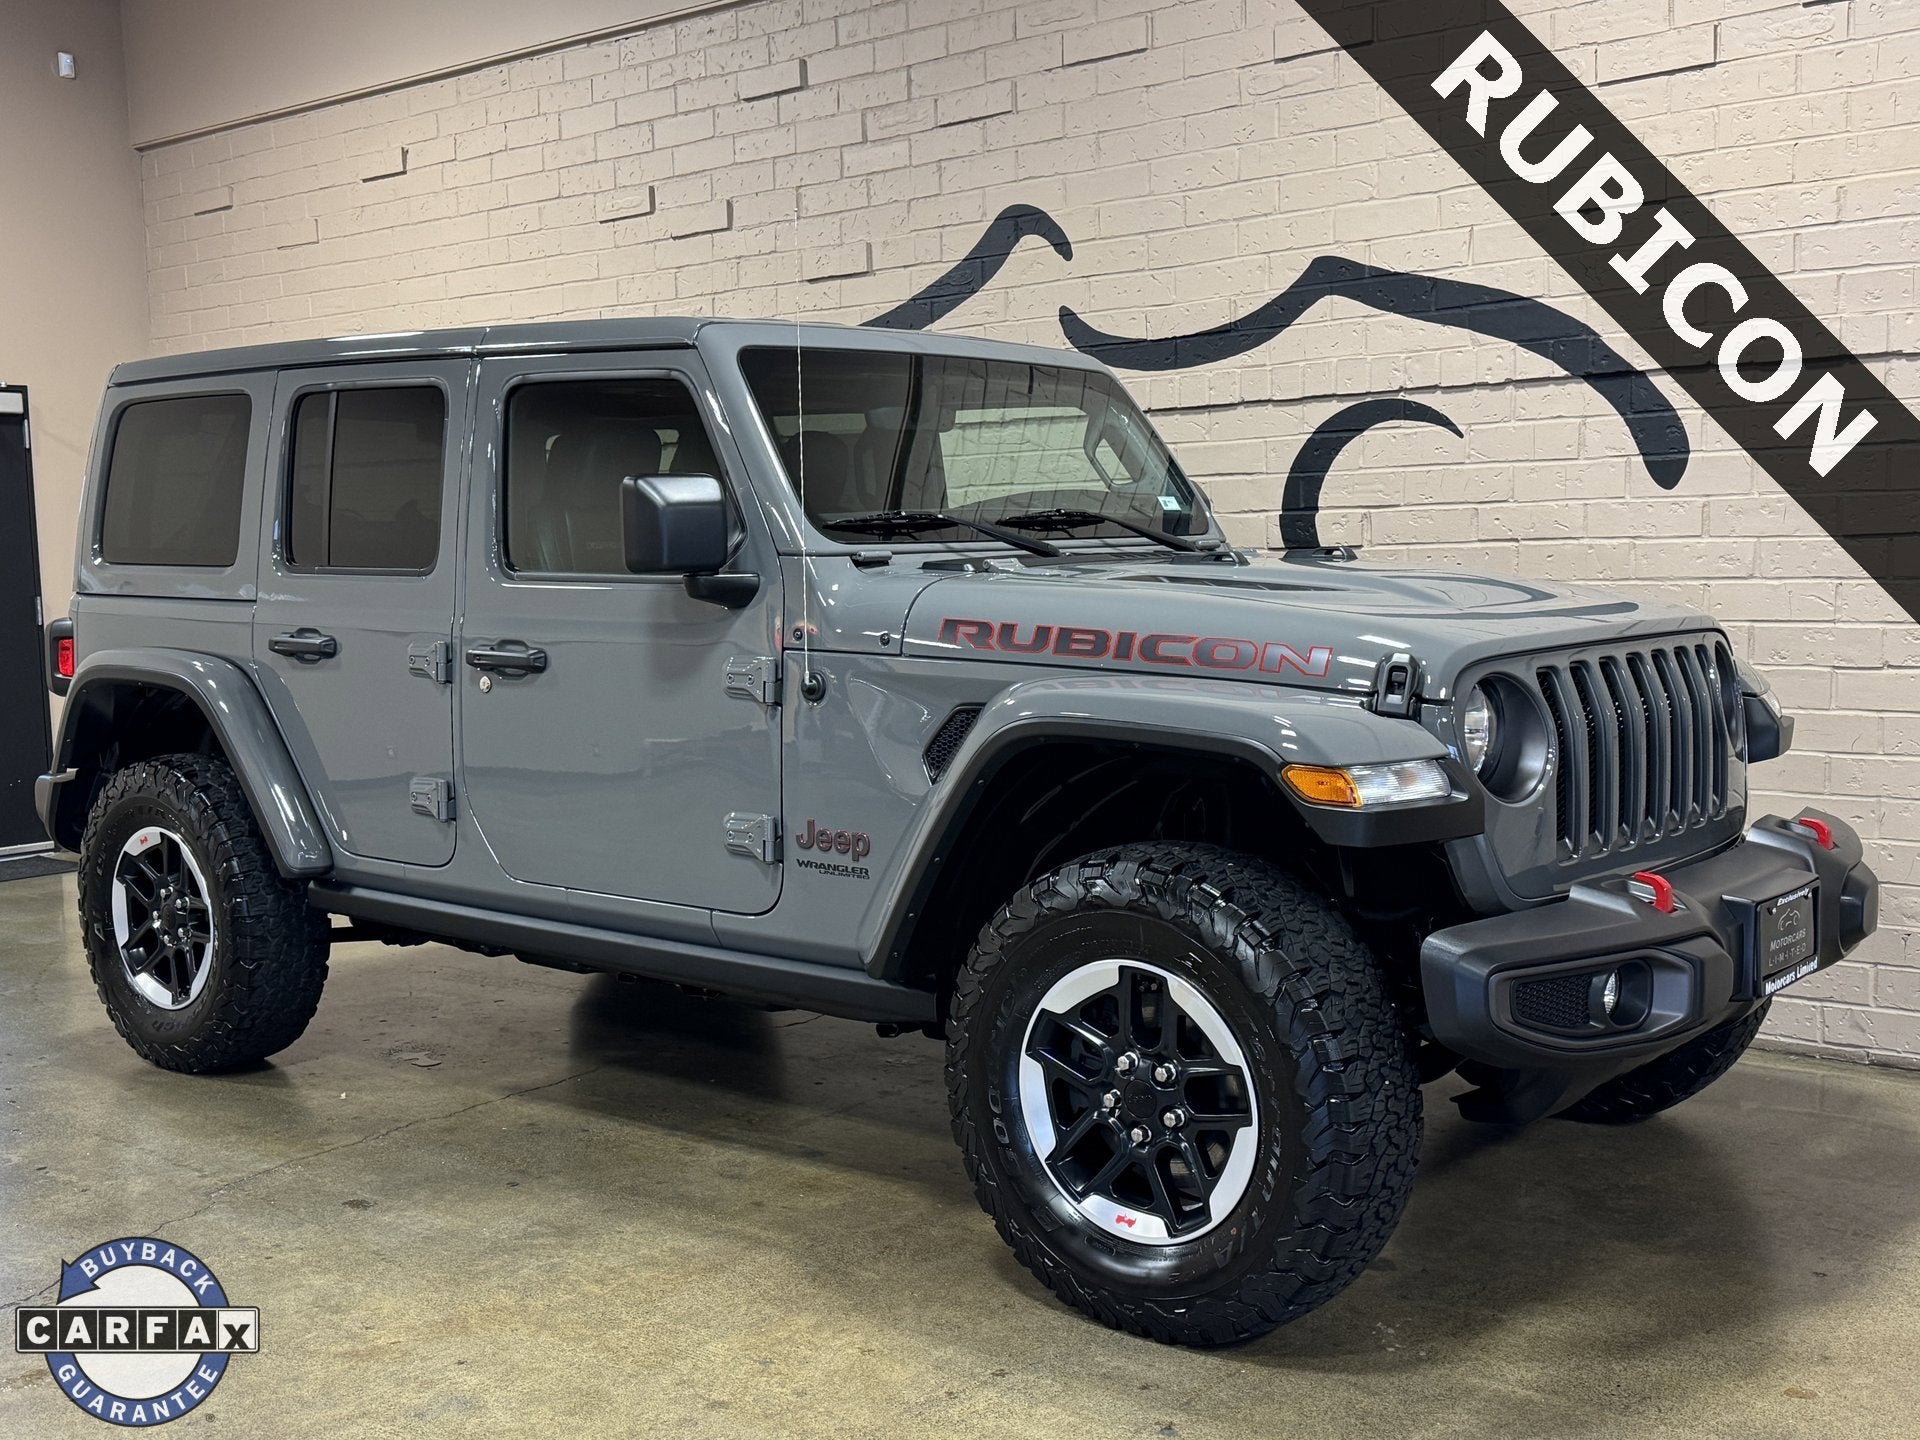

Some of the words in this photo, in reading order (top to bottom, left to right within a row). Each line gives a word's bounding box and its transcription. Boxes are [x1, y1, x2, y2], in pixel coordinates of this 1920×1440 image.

[937, 617, 1333, 678] RUBICON
[795, 817, 871, 862] Jeep
[796, 858, 869, 876] WRANGLER
[818, 869, 870, 880] UNLIMITED
[1770, 928, 1806, 953] MOTORCARS
[1765, 970, 1796, 996] Motorcars
